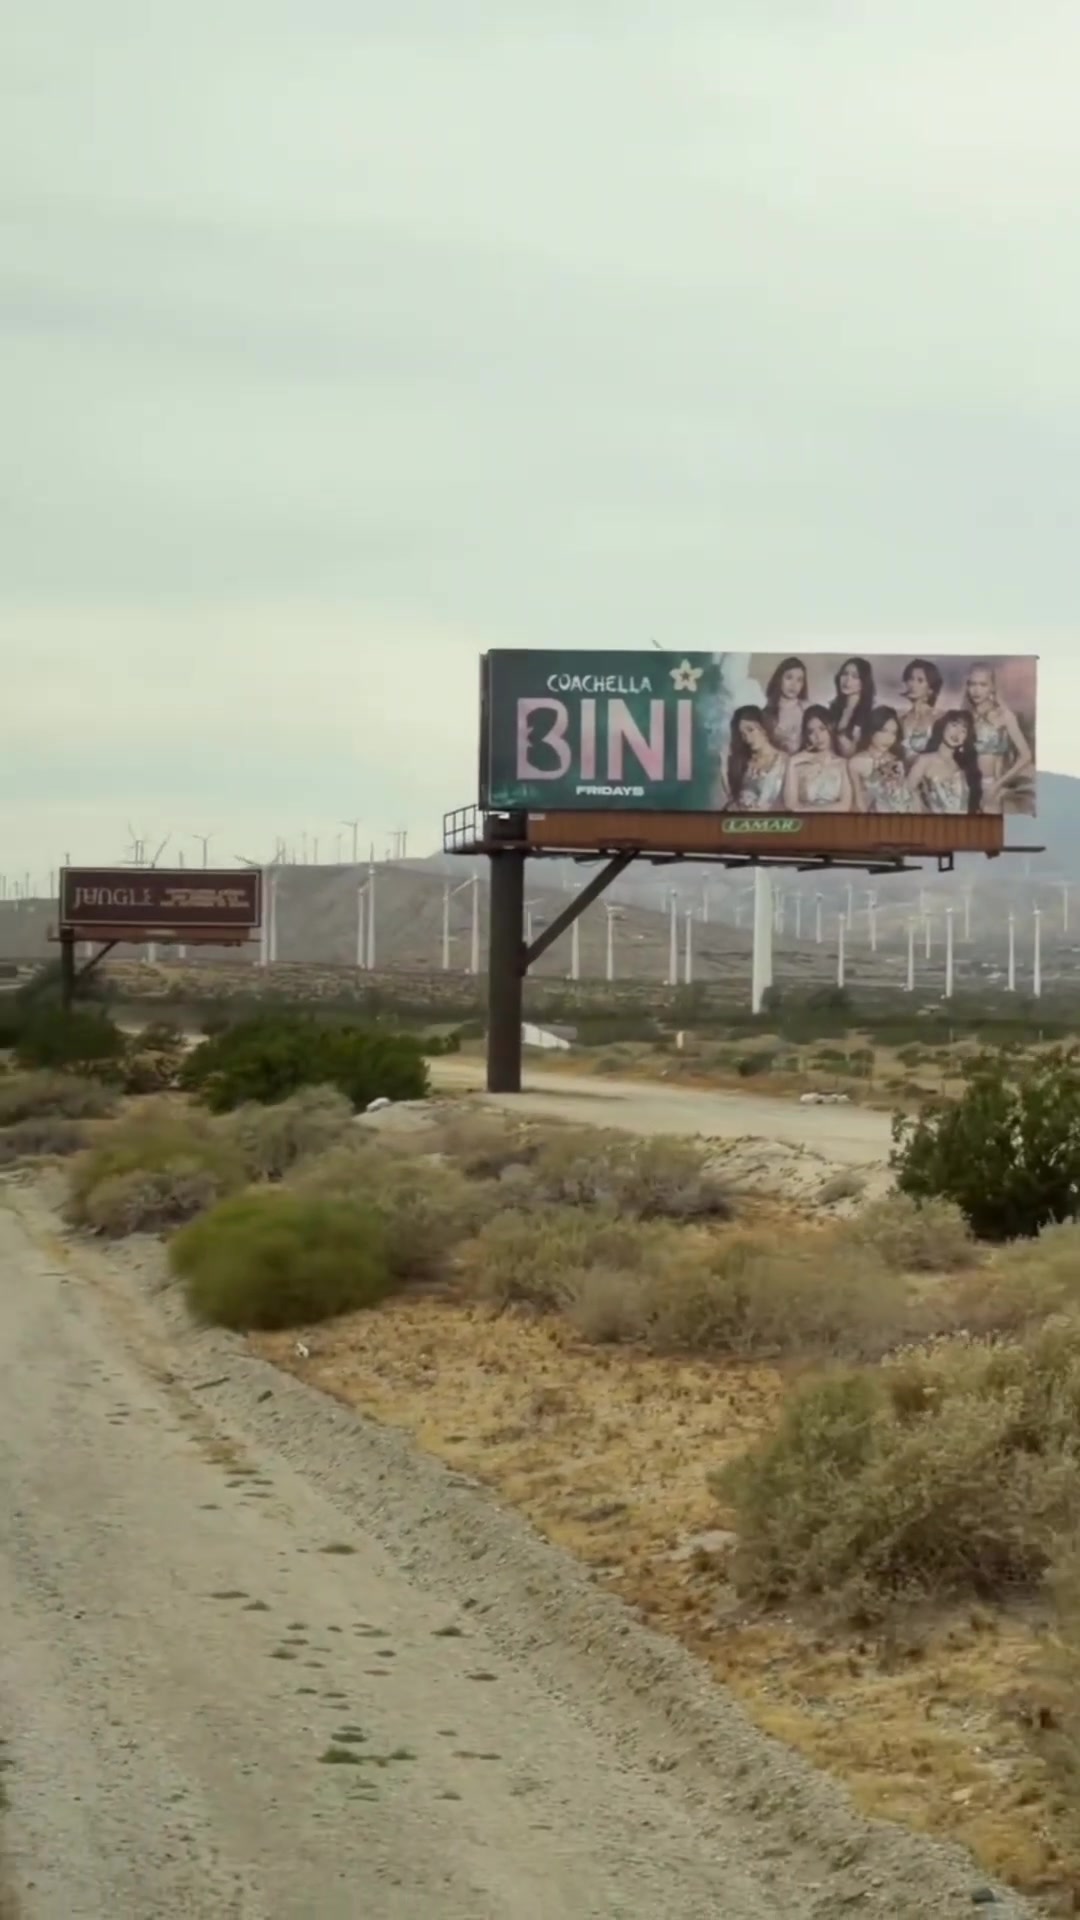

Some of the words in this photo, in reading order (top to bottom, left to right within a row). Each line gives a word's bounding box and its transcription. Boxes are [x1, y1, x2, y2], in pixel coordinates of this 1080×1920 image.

[547, 674, 652, 693] COACHELLA
[517, 698, 692, 781] BINI
[576, 786, 644, 796] FRIDAYS
[729, 820, 795, 832] LAMAR
[73, 887, 154, 908] JUNGLE
